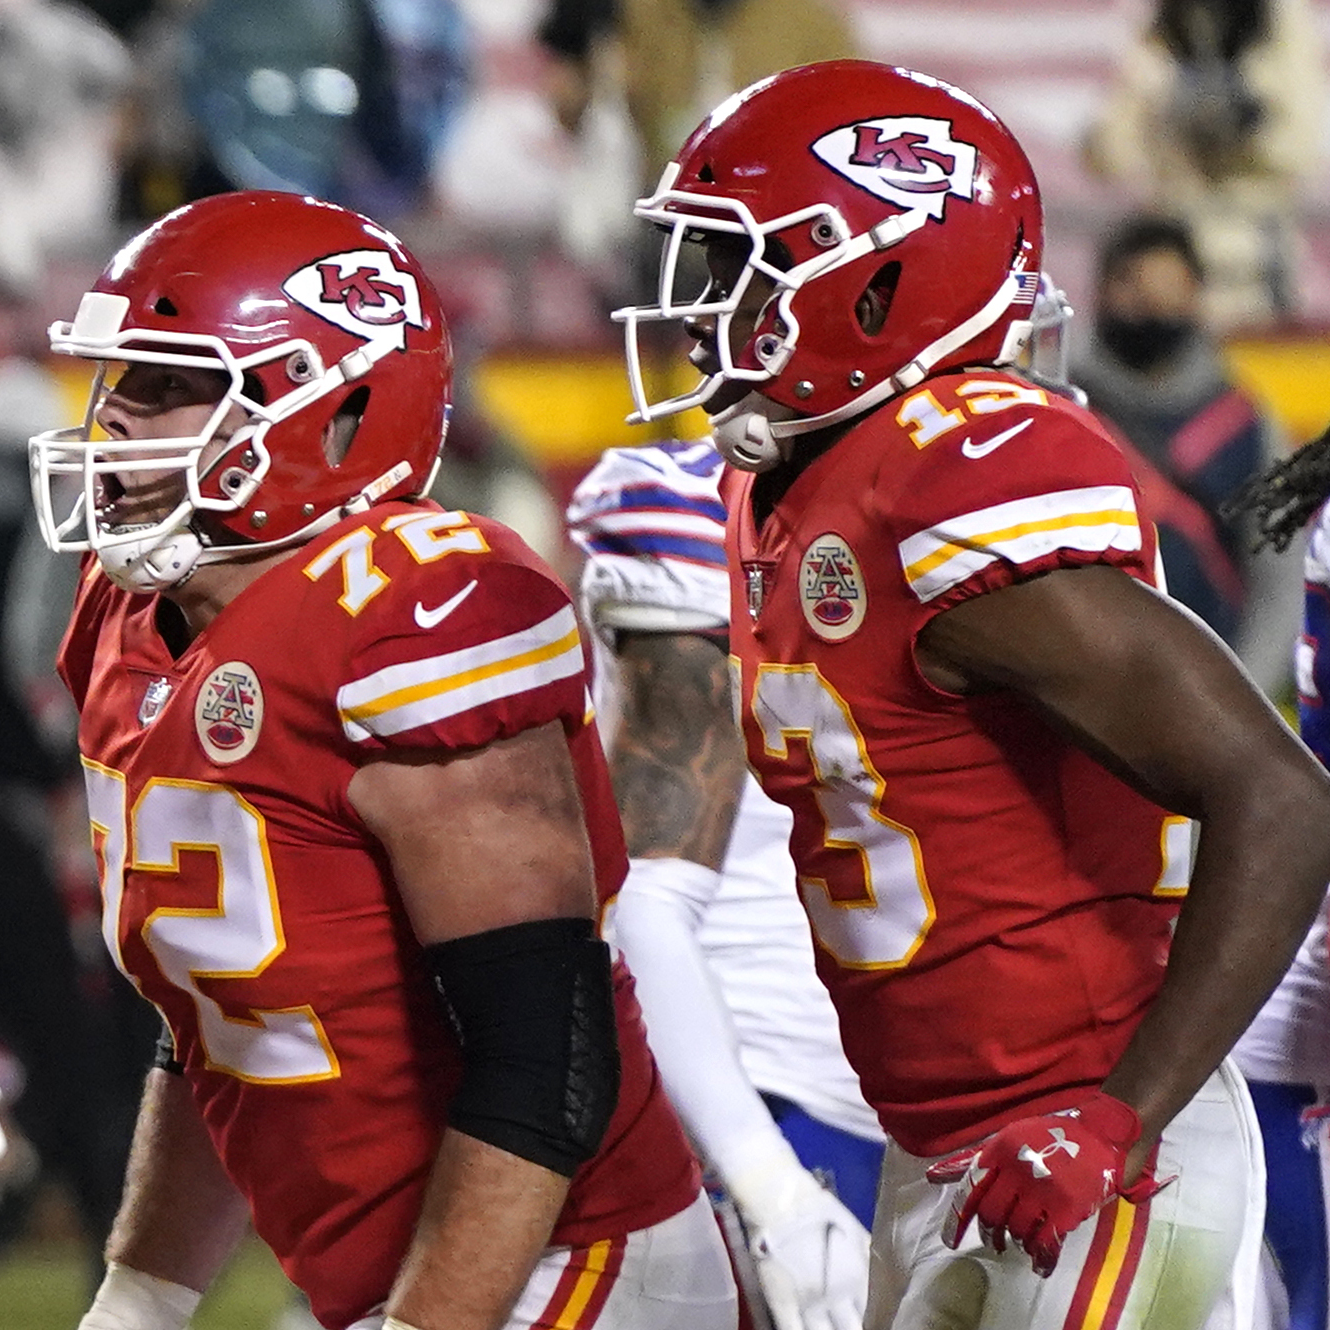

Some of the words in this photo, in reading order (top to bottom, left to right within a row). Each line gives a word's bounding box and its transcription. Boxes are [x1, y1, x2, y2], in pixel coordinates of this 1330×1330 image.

[848, 125, 956, 194] KC
[316, 263, 407, 326] KC
[302, 510, 491, 618] 72
[806, 547, 858, 599] A
[202, 671, 254, 729] A
[729, 656, 937, 970] 3
